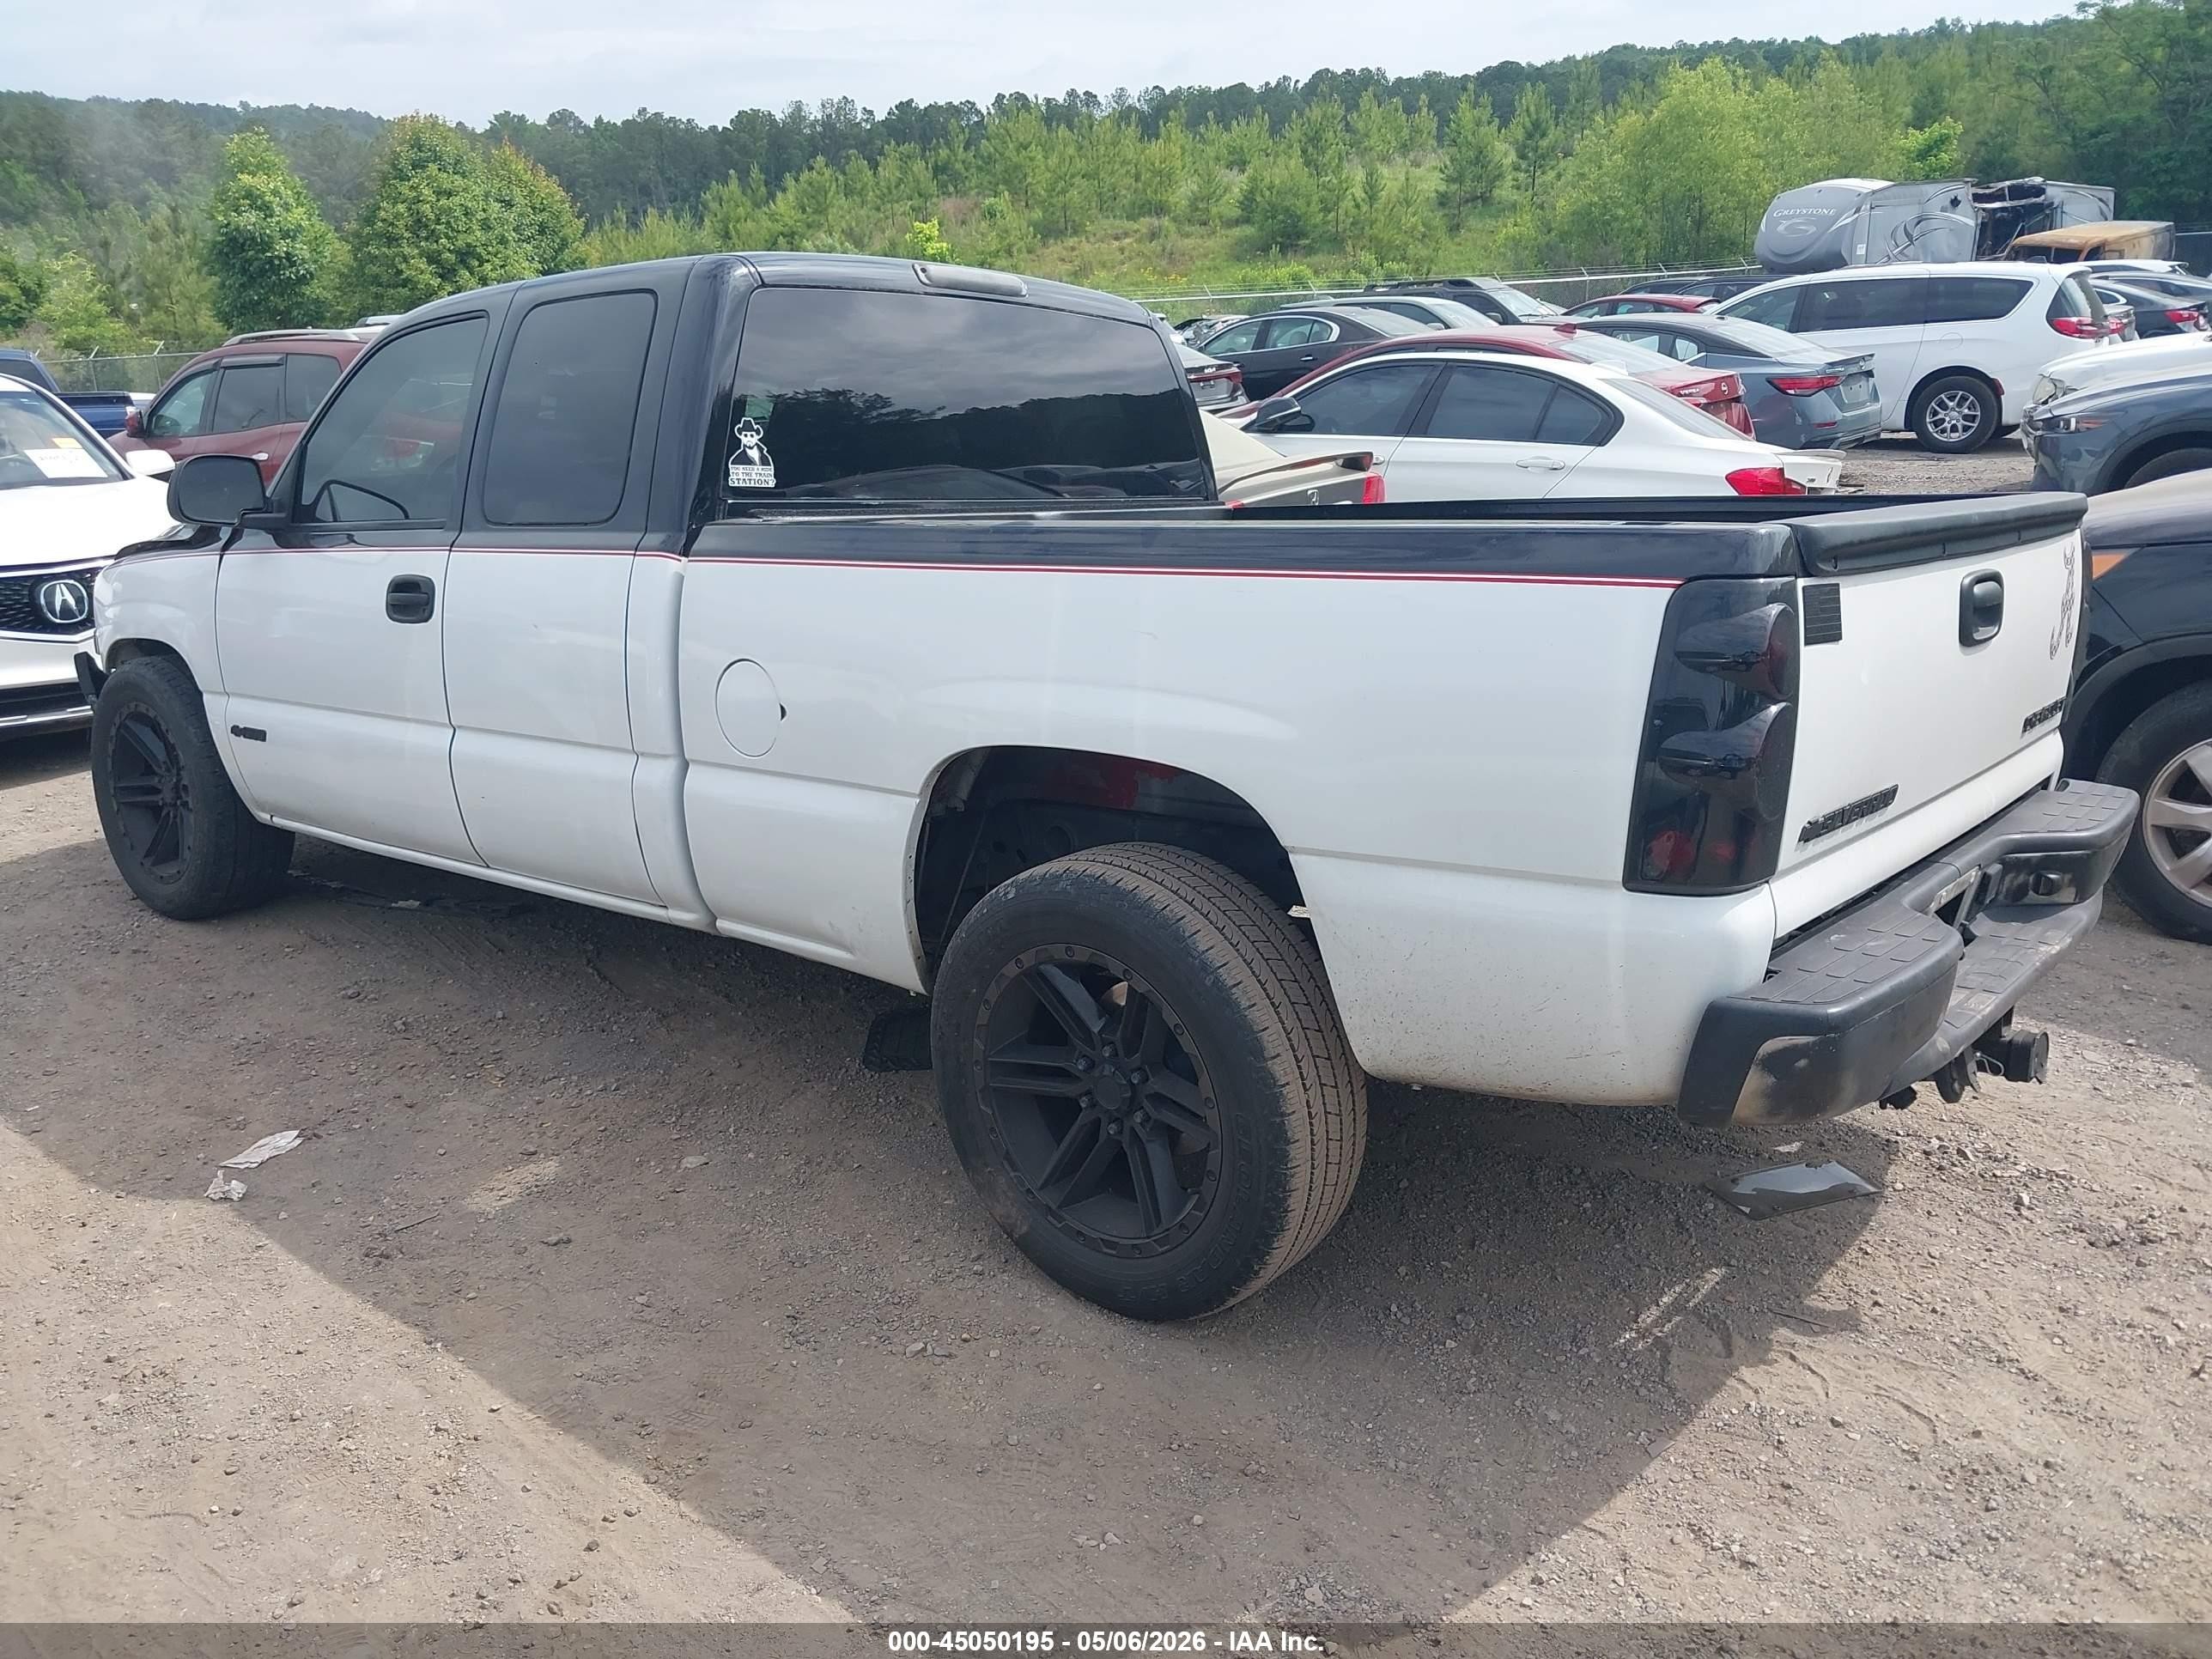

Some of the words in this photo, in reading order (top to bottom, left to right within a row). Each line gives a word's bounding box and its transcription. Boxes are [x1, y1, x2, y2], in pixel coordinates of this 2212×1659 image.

[1773, 208, 1836, 217] GREYSTONE
[730, 477, 775, 486] STATION?
[1820, 783, 1899, 836] SILVERADO
